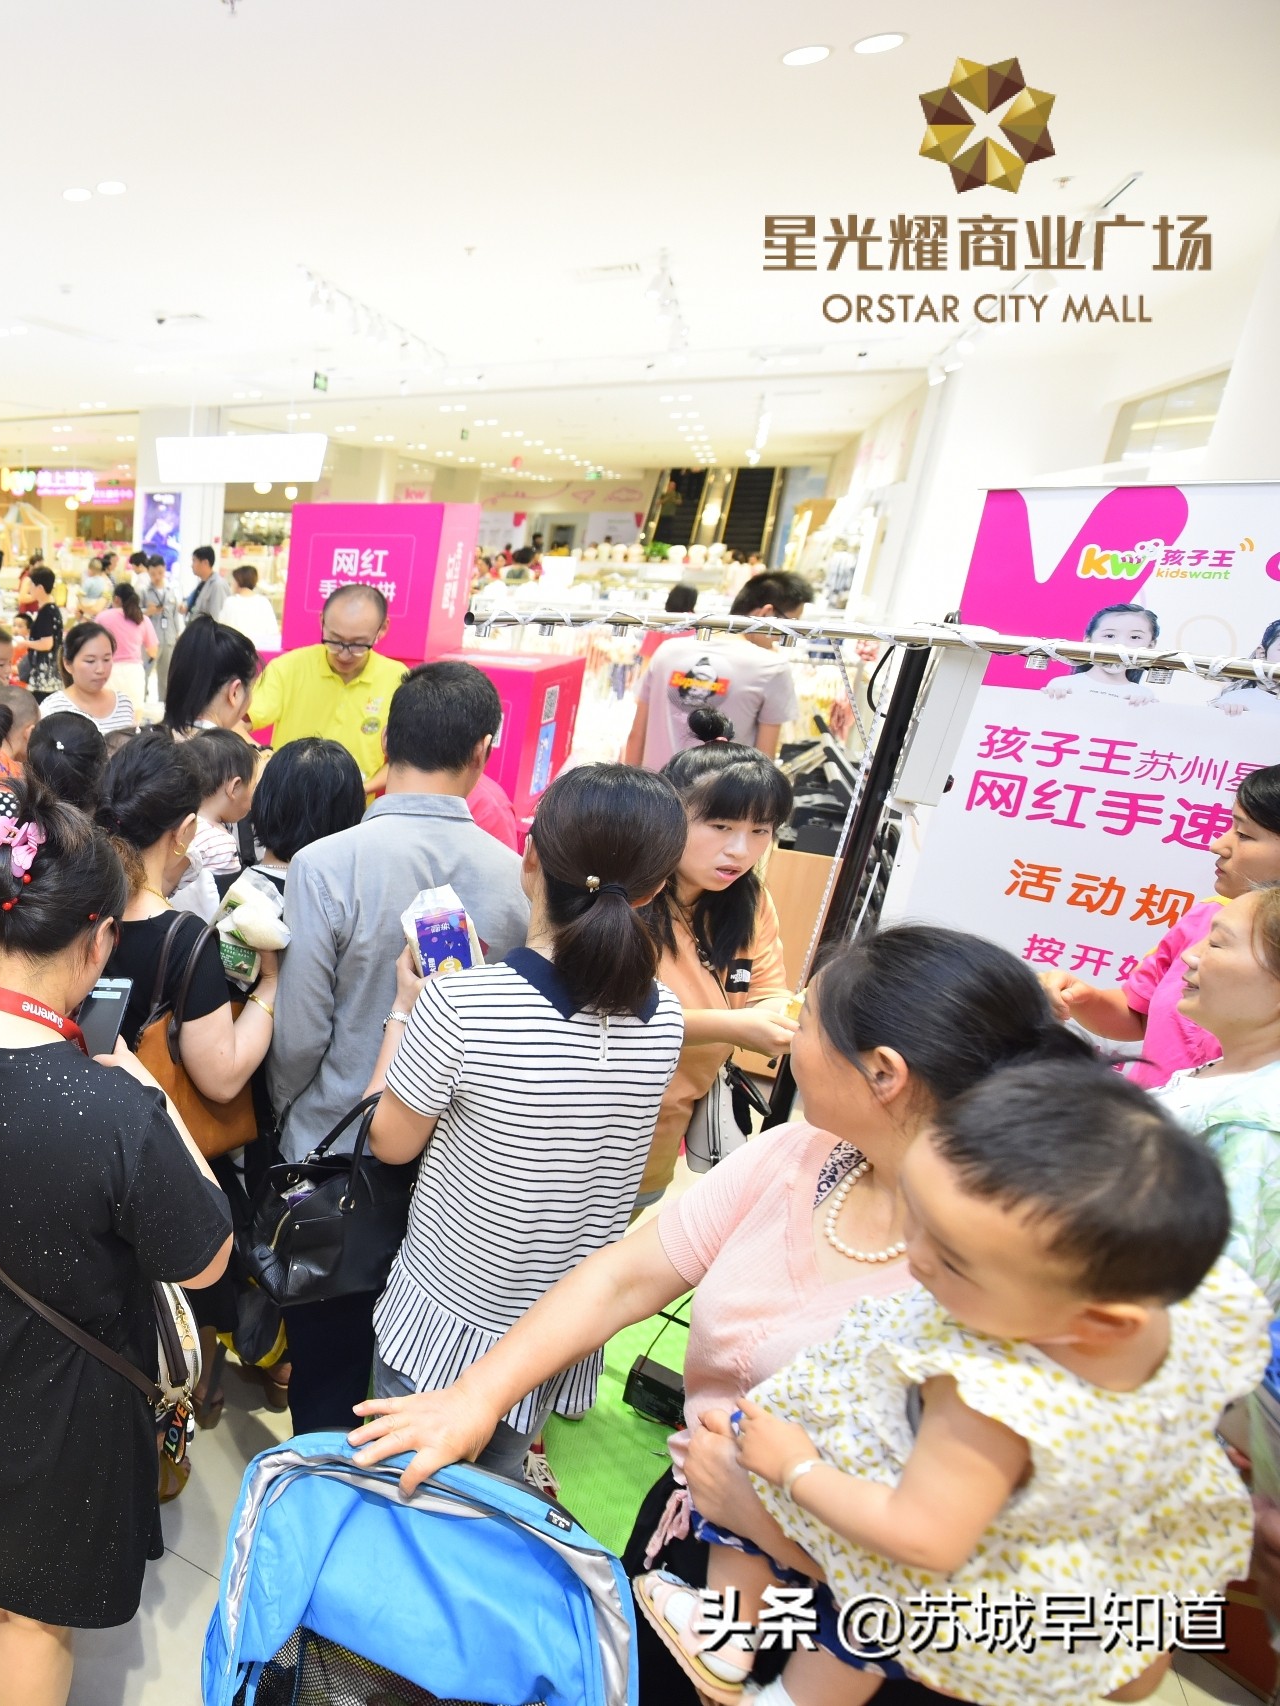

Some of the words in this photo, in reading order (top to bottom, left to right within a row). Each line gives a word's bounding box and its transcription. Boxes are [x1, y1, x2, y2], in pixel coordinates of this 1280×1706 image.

[331, 547, 390, 578] 网红
[1080, 547, 1147, 578] kw
[1155, 567, 1231, 580] kidswant
[1159, 549, 1236, 568] 孩子王
[318, 578, 397, 603] 手拼
[964, 769, 1233, 852] 网红手速
[1004, 858, 1196, 929] 活动规
[21, 1001, 64, 1029] Supreme
[164, 1402, 188, 1453] LOVE
